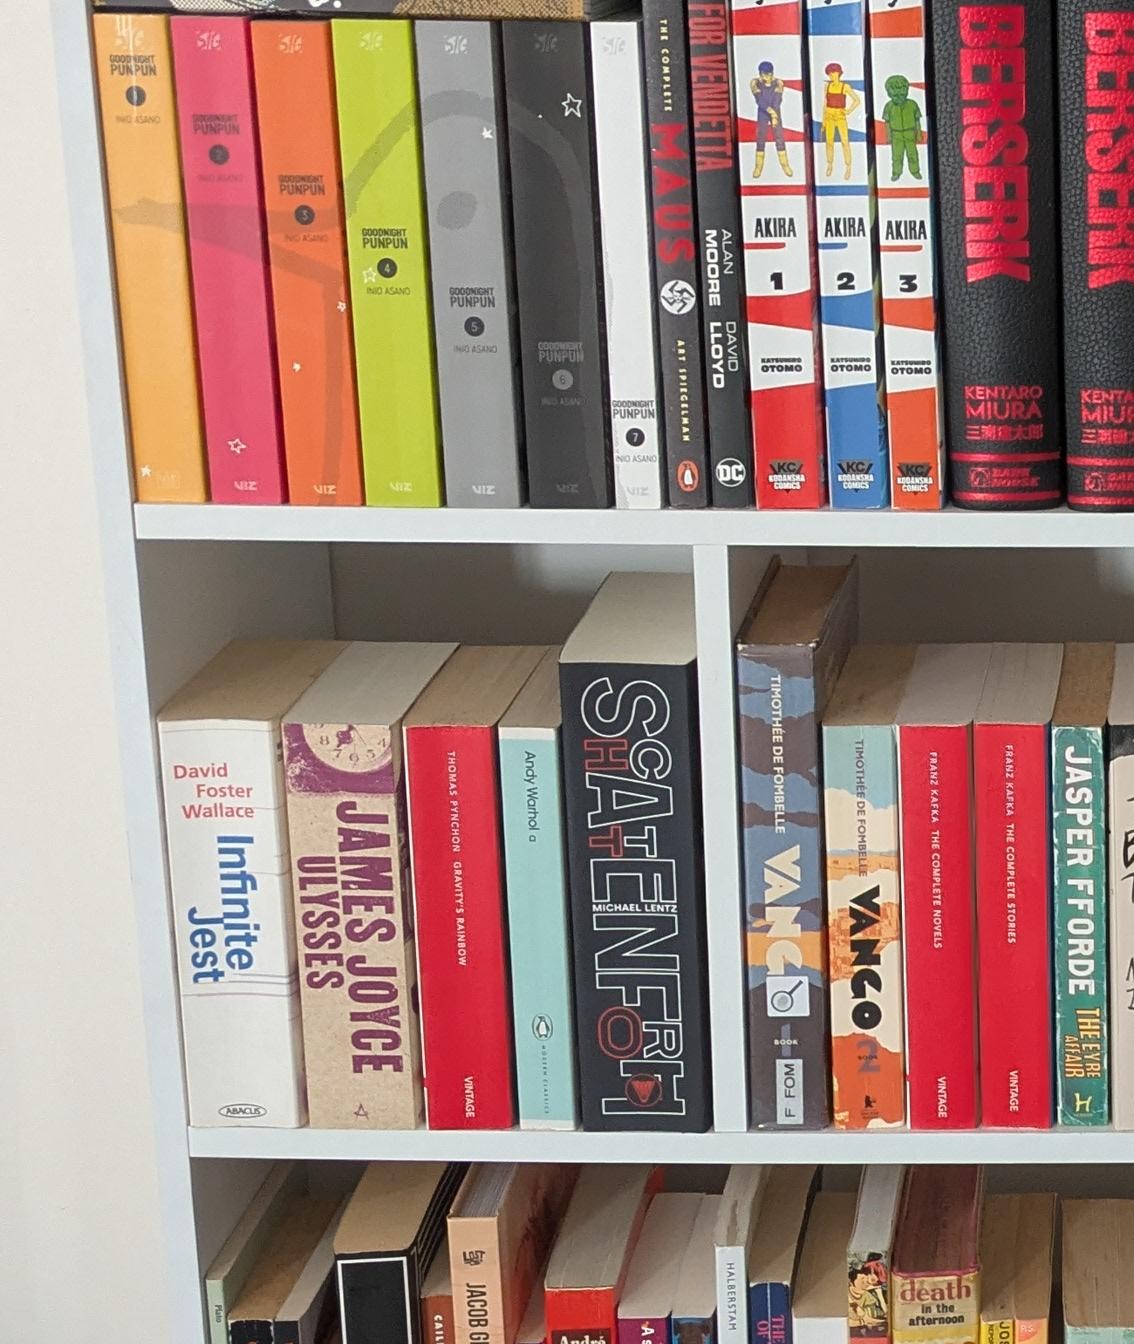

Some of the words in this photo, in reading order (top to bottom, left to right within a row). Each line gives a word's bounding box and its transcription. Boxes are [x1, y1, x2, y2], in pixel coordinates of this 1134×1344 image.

[959, 5, 1031, 284] BERSERK
[650, 123, 694, 265] MAUS
[362, 236, 409, 250] PUNPUN
[754, 216, 797, 240] AKIRA
[824, 216, 865, 238] AKIRA
[704, 228, 721, 307] MOORE
[709, 320, 725, 389] LLOYD
[964, 385, 1043, 401] KENTARO
[965, 400, 1043, 420] MIURA
[173, 763, 228, 780] David
[196, 783, 253, 799] Foster
[182, 803, 254, 819] Wallace
[451, 800, 461, 853] PYNCHON
[527, 789, 538, 831] Warhol
[773, 766, 786, 834] FOMBELLE
[930, 789, 939, 824] KAFKA
[1065, 746, 1094, 867] JASPER
[336, 801, 396, 942] JAMES
[216, 835, 255, 971] Infinite
[296, 856, 344, 990] ULYSSES
[592, 904, 641, 913] MICHAEL
[644, 904, 678, 913] LENTZ
[932, 910, 943, 949] NOVELS
[189, 907, 226, 983] Jest
[455, 912, 467, 967] RAINBOW
[848, 885, 883, 1030] VANGO
[1065, 878, 1095, 996] FFORDE
[345, 955, 404, 1074] JOYCE
[466, 1281, 489, 1328] JACOB
[900, 1280, 971, 1304] death
